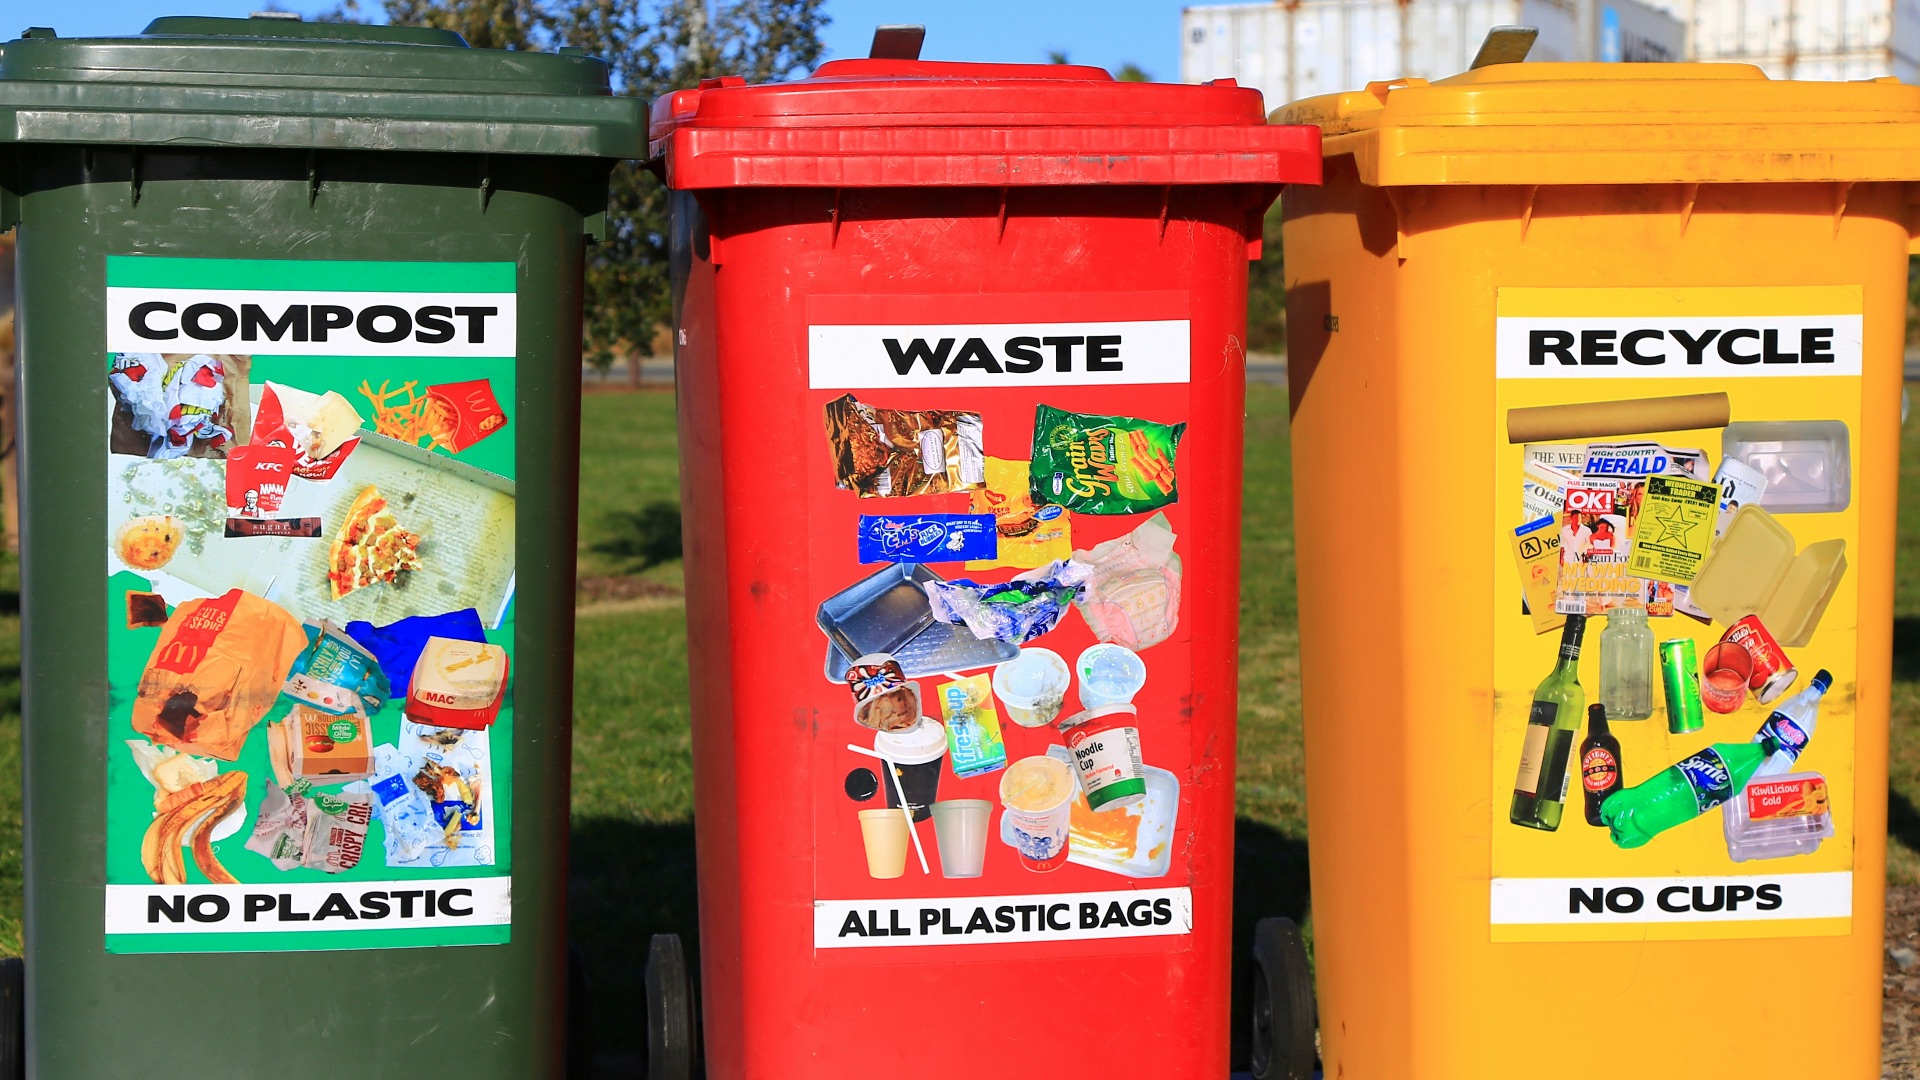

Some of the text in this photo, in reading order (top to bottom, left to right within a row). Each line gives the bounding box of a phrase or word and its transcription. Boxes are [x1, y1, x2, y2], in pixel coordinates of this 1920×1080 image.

[129, 302, 497, 344] COMPOST
[882, 335, 1123, 375] WASTE
[1528, 327, 1835, 366] RECYCLE
[1085, 428, 1119, 482] Waves
[1532, 451, 1585, 464] THE WEE
[1615, 449, 1657, 457] COUNTRY
[255, 462, 283, 472] KFC
[1065, 440, 1111, 497] Grain
[1585, 456, 1667, 474] HERALD
[1664, 480, 1703, 492] WEDNESDAY
[1670, 487, 1696, 498] TRADER
[1534, 486, 1564, 507] Otag
[1568, 491, 1612, 509] OK!
[920, 526, 938, 539] RICE
[1614, 553, 1629, 563] Fo
[1562, 562, 1589, 577] MY
[1562, 577, 1641, 593] WEDDING
[306, 647, 334, 679] RESHLY
[426, 692, 455, 704] MAC
[1075, 742, 1104, 761] Noodle
[1079, 758, 1094, 771] Cup
[1679, 756, 1728, 784] Sprite
[1751, 785, 1799, 796] KiwiLicious
[1762, 796, 1781, 806] Gold
[339, 829, 363, 869] CRISPY
[147, 889, 473, 923] NO PLASTIC
[1569, 883, 1783, 914] NO CUPS
[838, 898, 1172, 938] ALL PLASTIC BAGS
